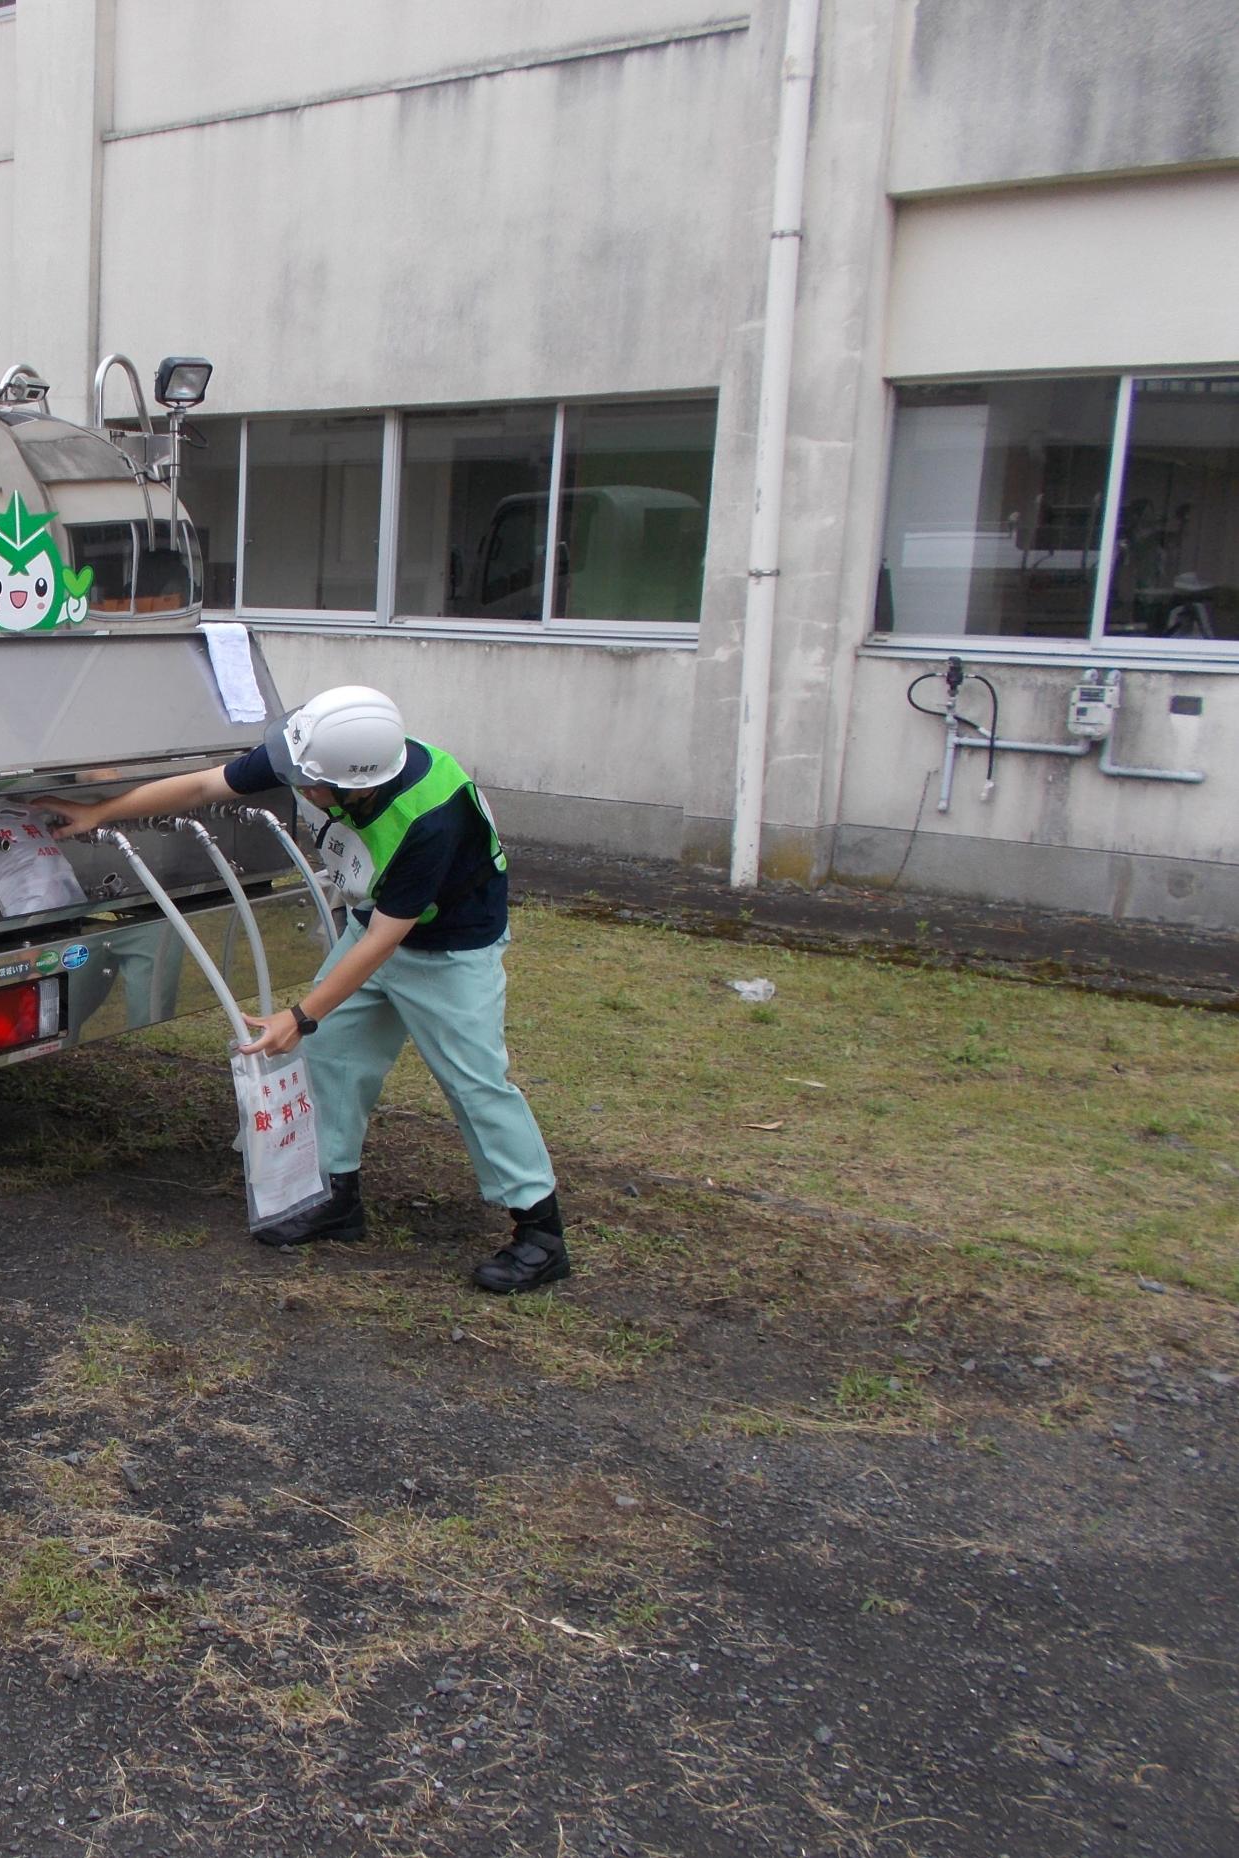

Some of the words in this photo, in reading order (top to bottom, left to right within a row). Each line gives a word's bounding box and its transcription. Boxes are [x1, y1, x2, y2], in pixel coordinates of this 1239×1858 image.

[348, 764, 379, 774] 茨城町
[263, 1071, 299, 1097] 非常用
[253, 1092, 312, 1132] 飲料水
